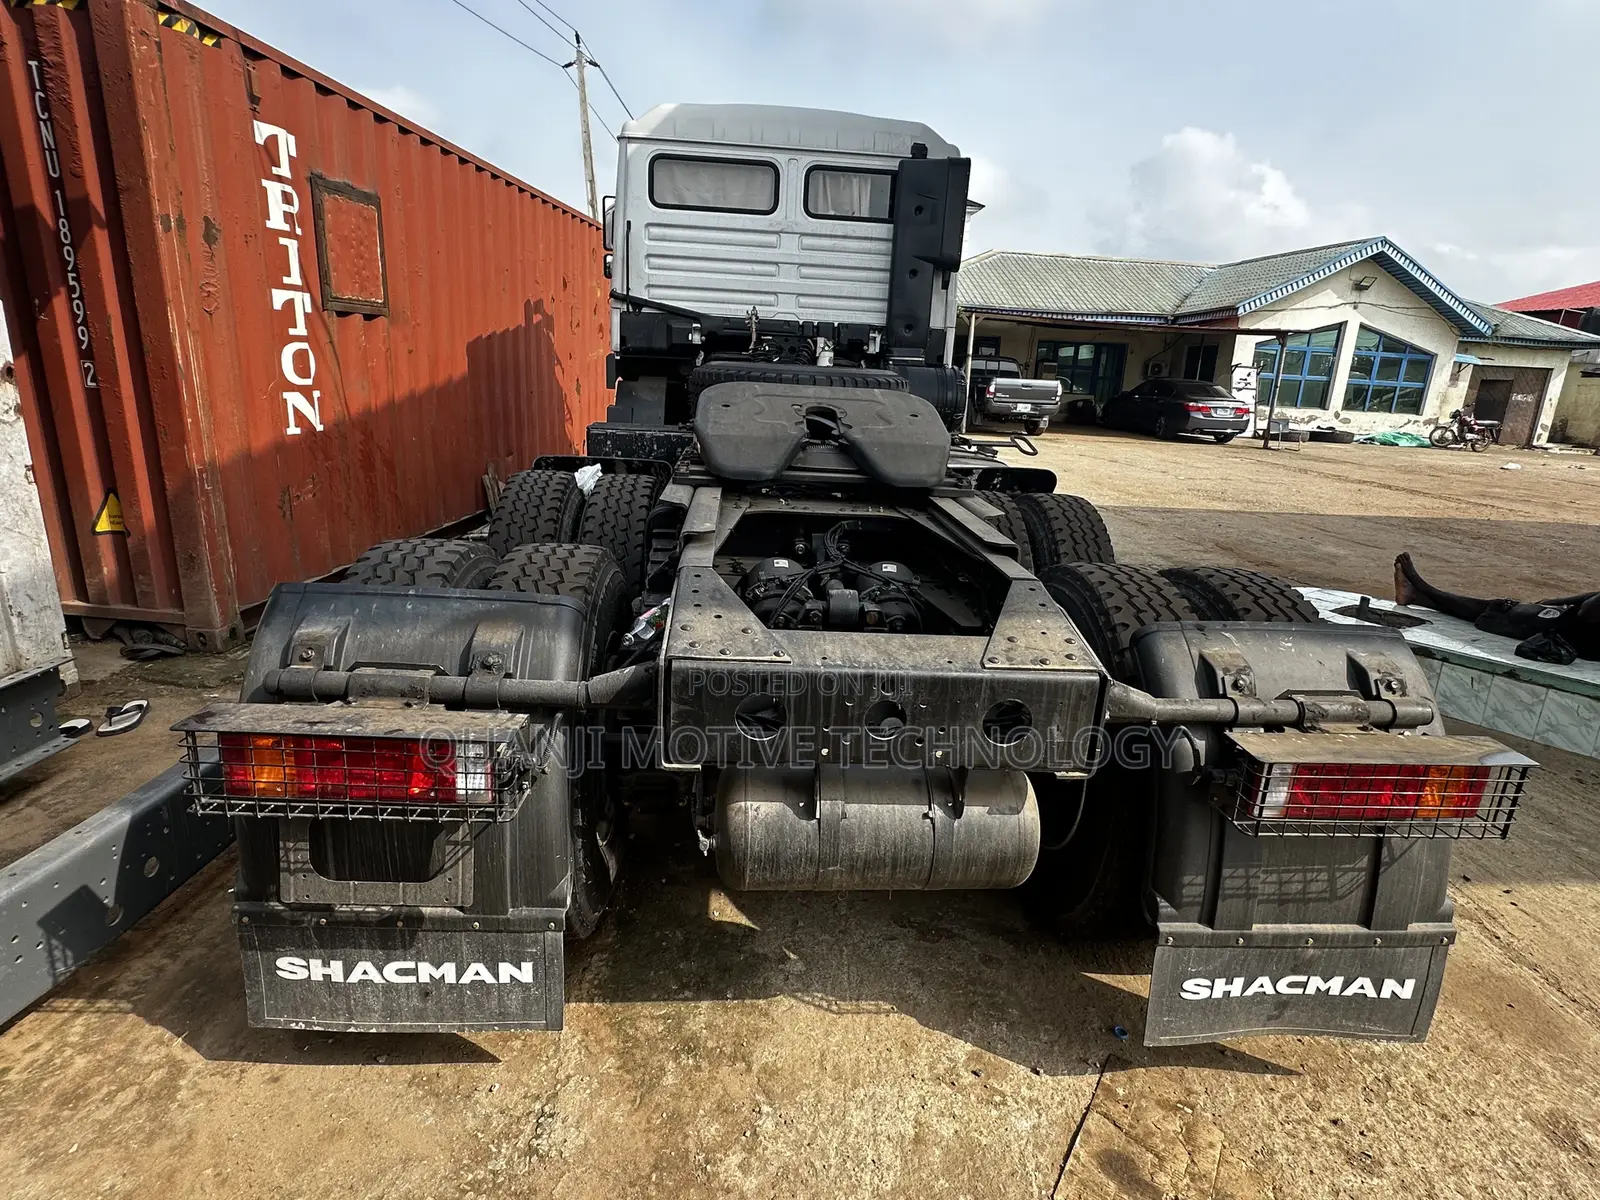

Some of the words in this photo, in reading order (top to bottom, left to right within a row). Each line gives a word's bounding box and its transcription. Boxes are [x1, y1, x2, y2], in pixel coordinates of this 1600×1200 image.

[28, 60, 60, 178] TCNU
[55, 189, 89, 350] 189599
[83, 361, 98, 387] 2
[253, 119, 324, 436] TRITON
[275, 957, 534, 984] SHACMAN
[1180, 975, 1416, 1000] SHACMAN
